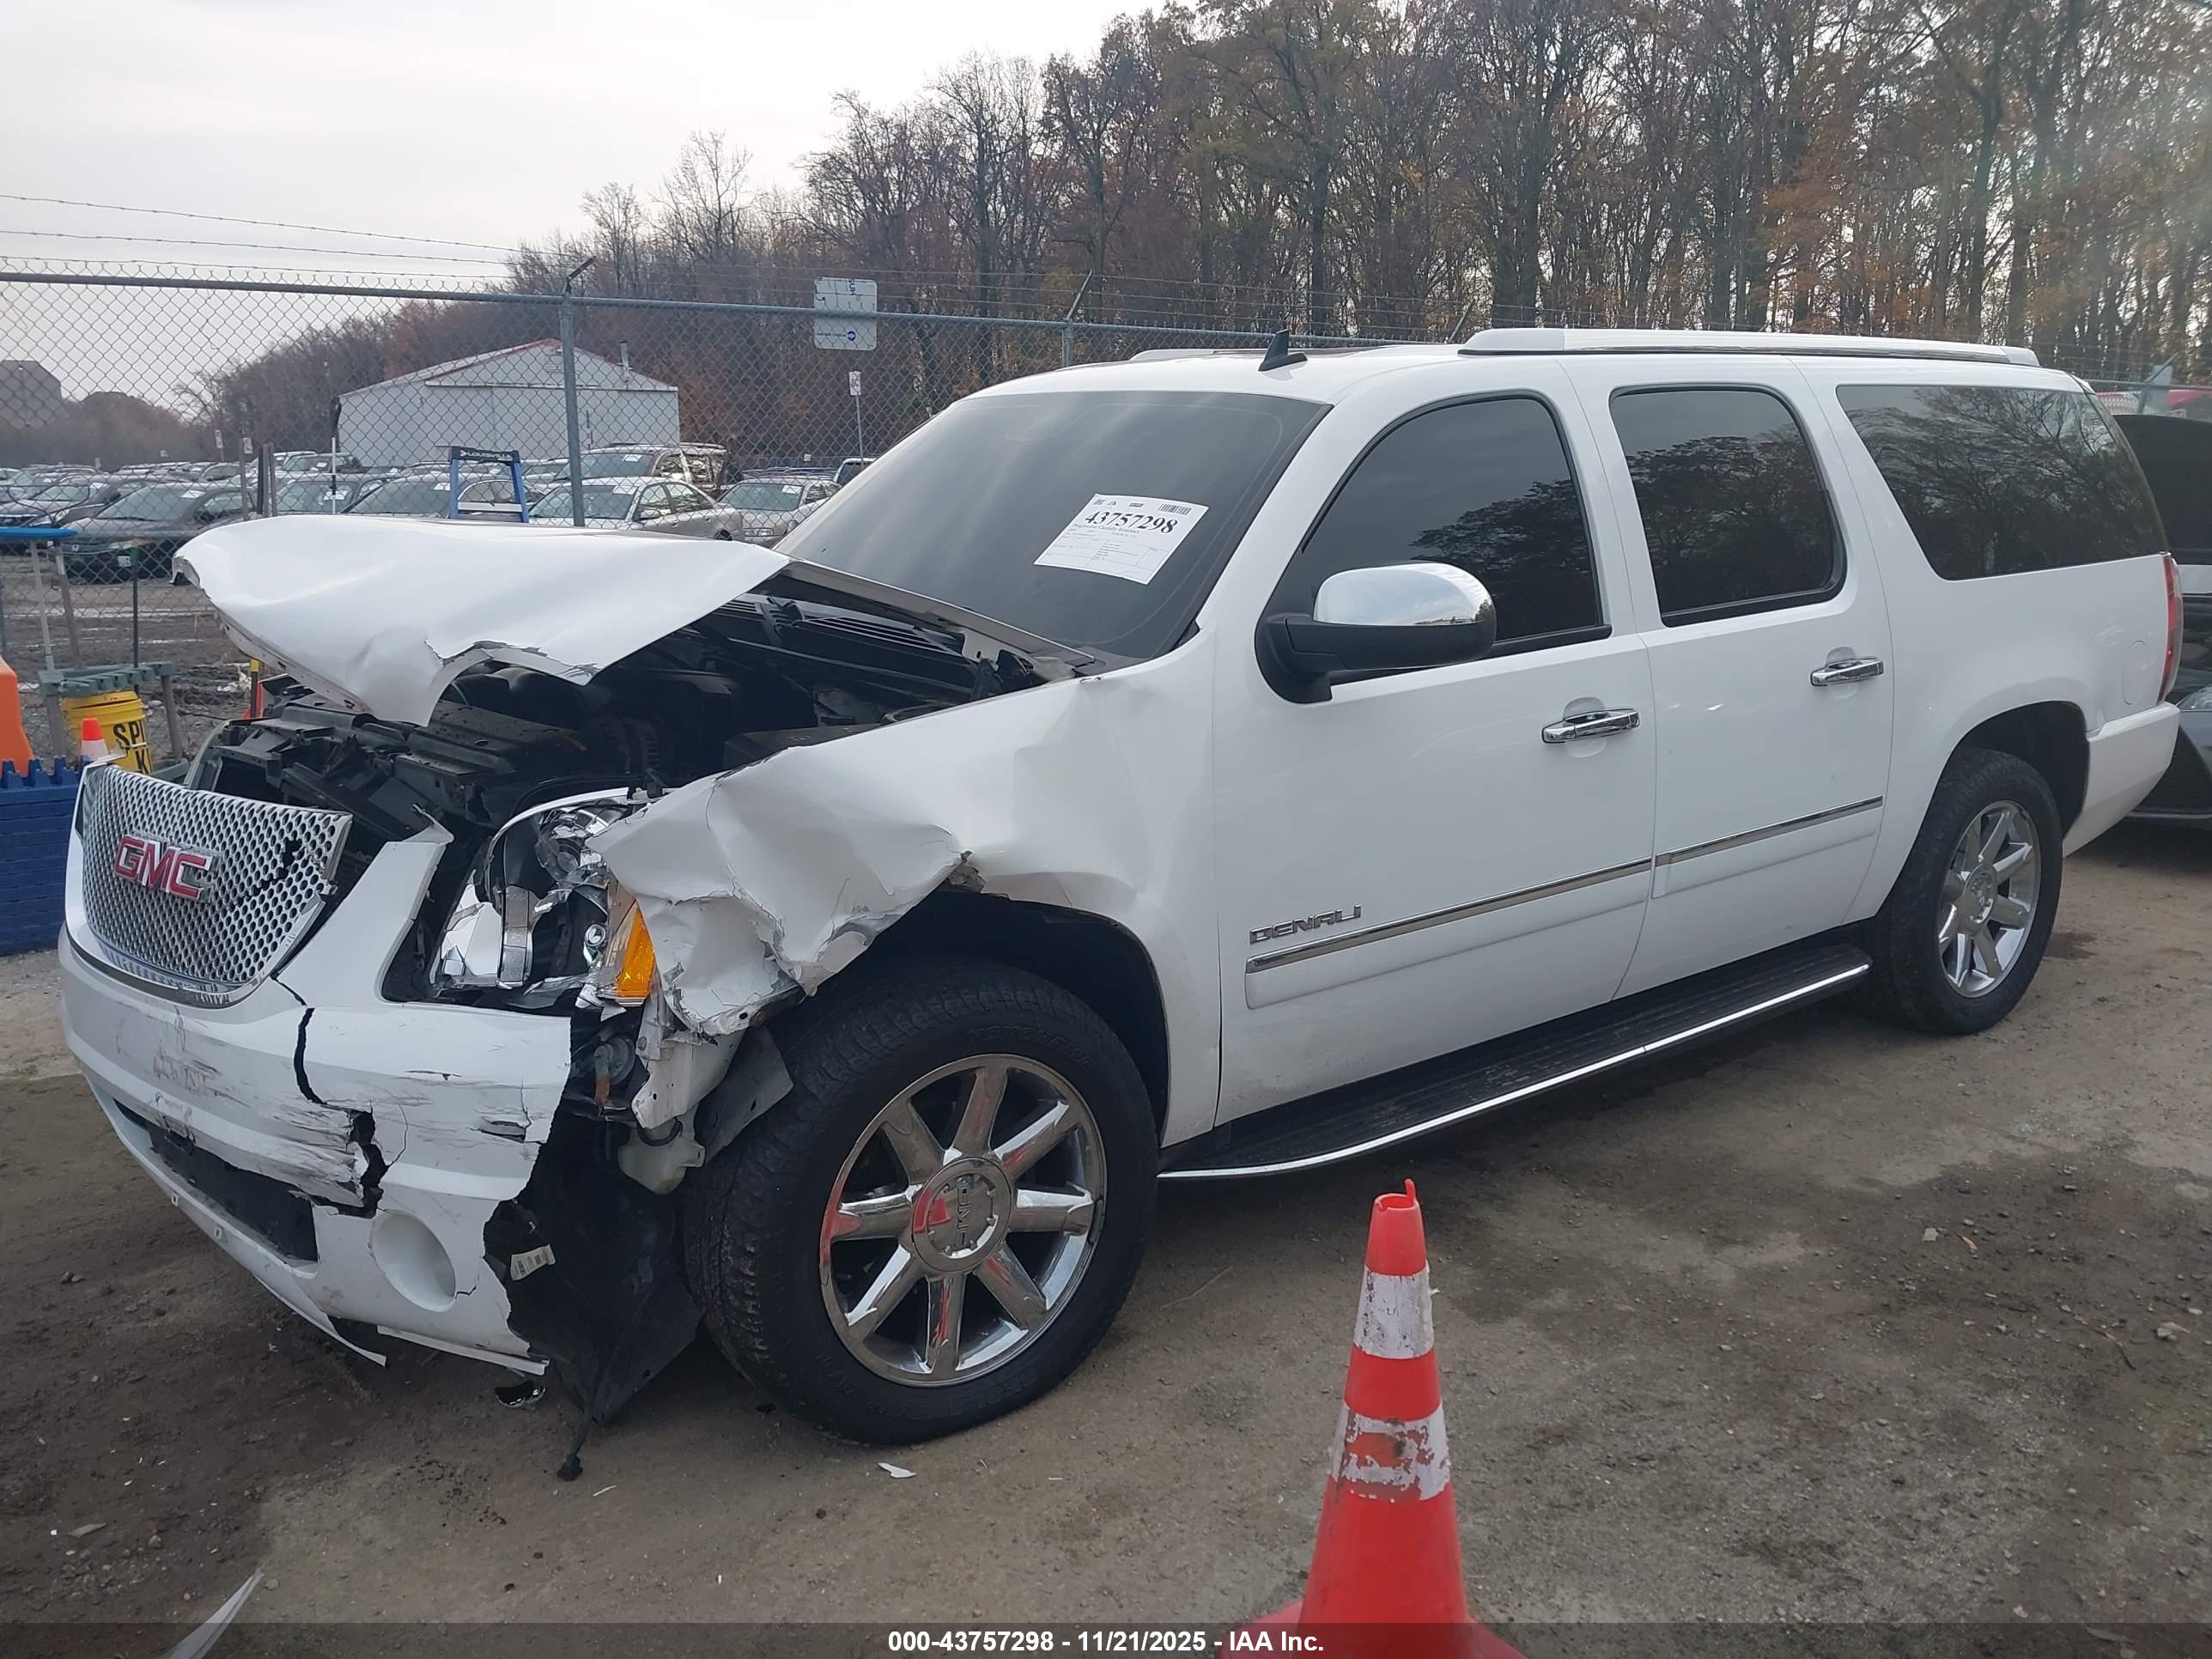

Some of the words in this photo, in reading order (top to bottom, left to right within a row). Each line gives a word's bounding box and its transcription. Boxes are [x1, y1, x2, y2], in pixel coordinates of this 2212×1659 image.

[1085, 510, 1179, 534] 43757298
[114, 835, 213, 900] GMC
[1249, 903, 1361, 945] DENALI
